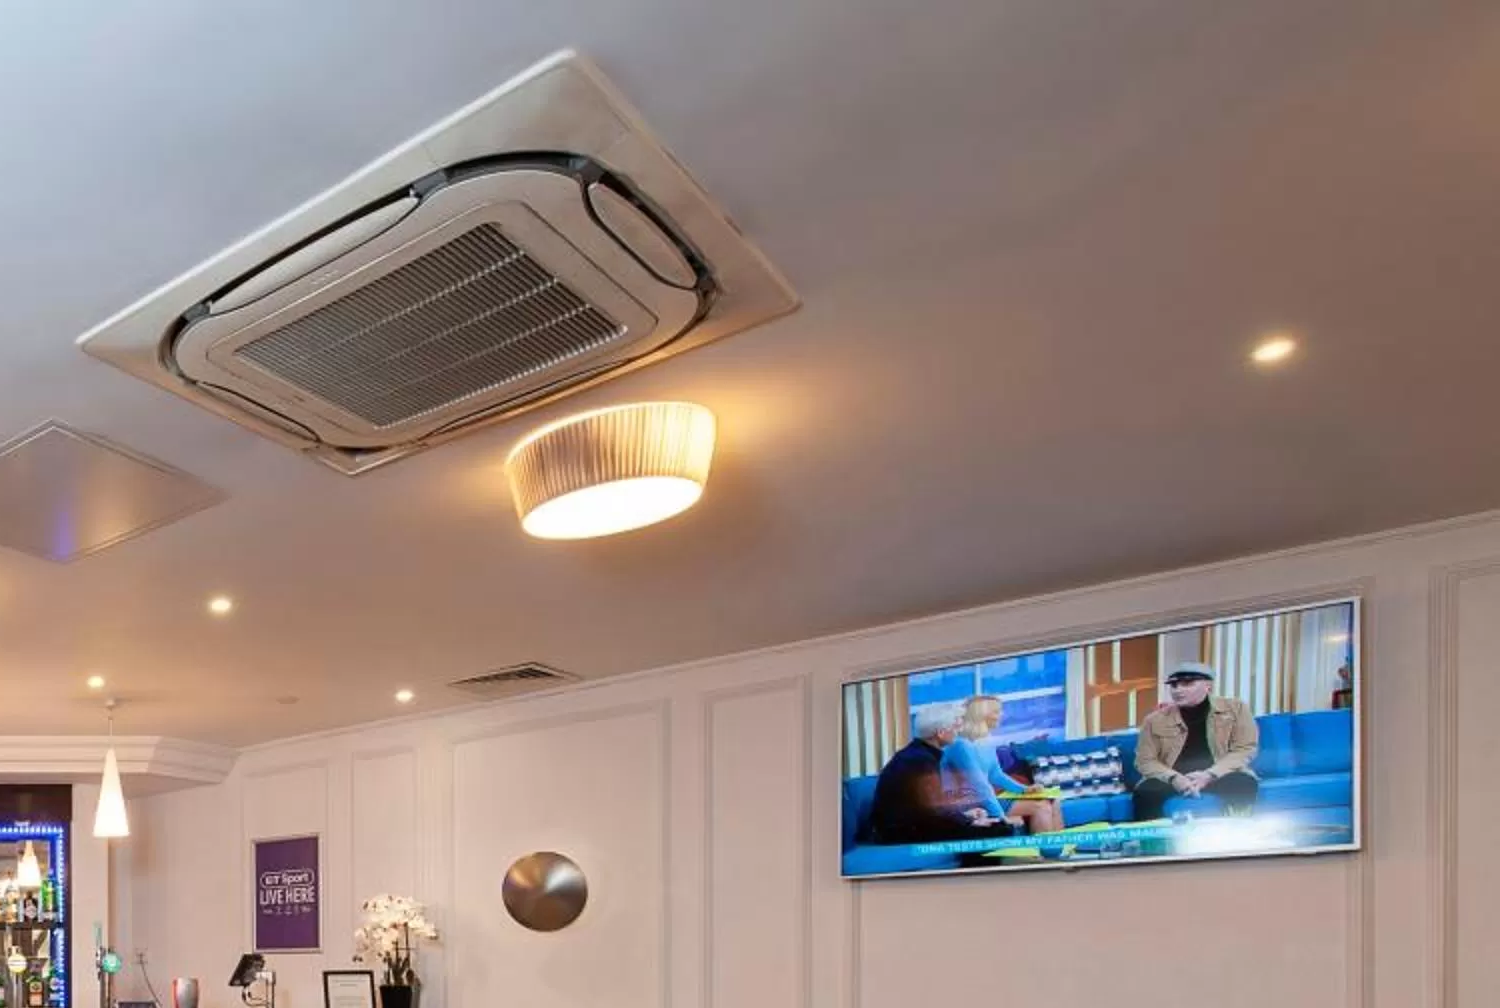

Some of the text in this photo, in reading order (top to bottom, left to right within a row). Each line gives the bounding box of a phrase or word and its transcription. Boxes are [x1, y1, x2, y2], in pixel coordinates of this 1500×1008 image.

[282, 872, 309, 885] Sport
[260, 886, 315, 905] LIVE HERE
